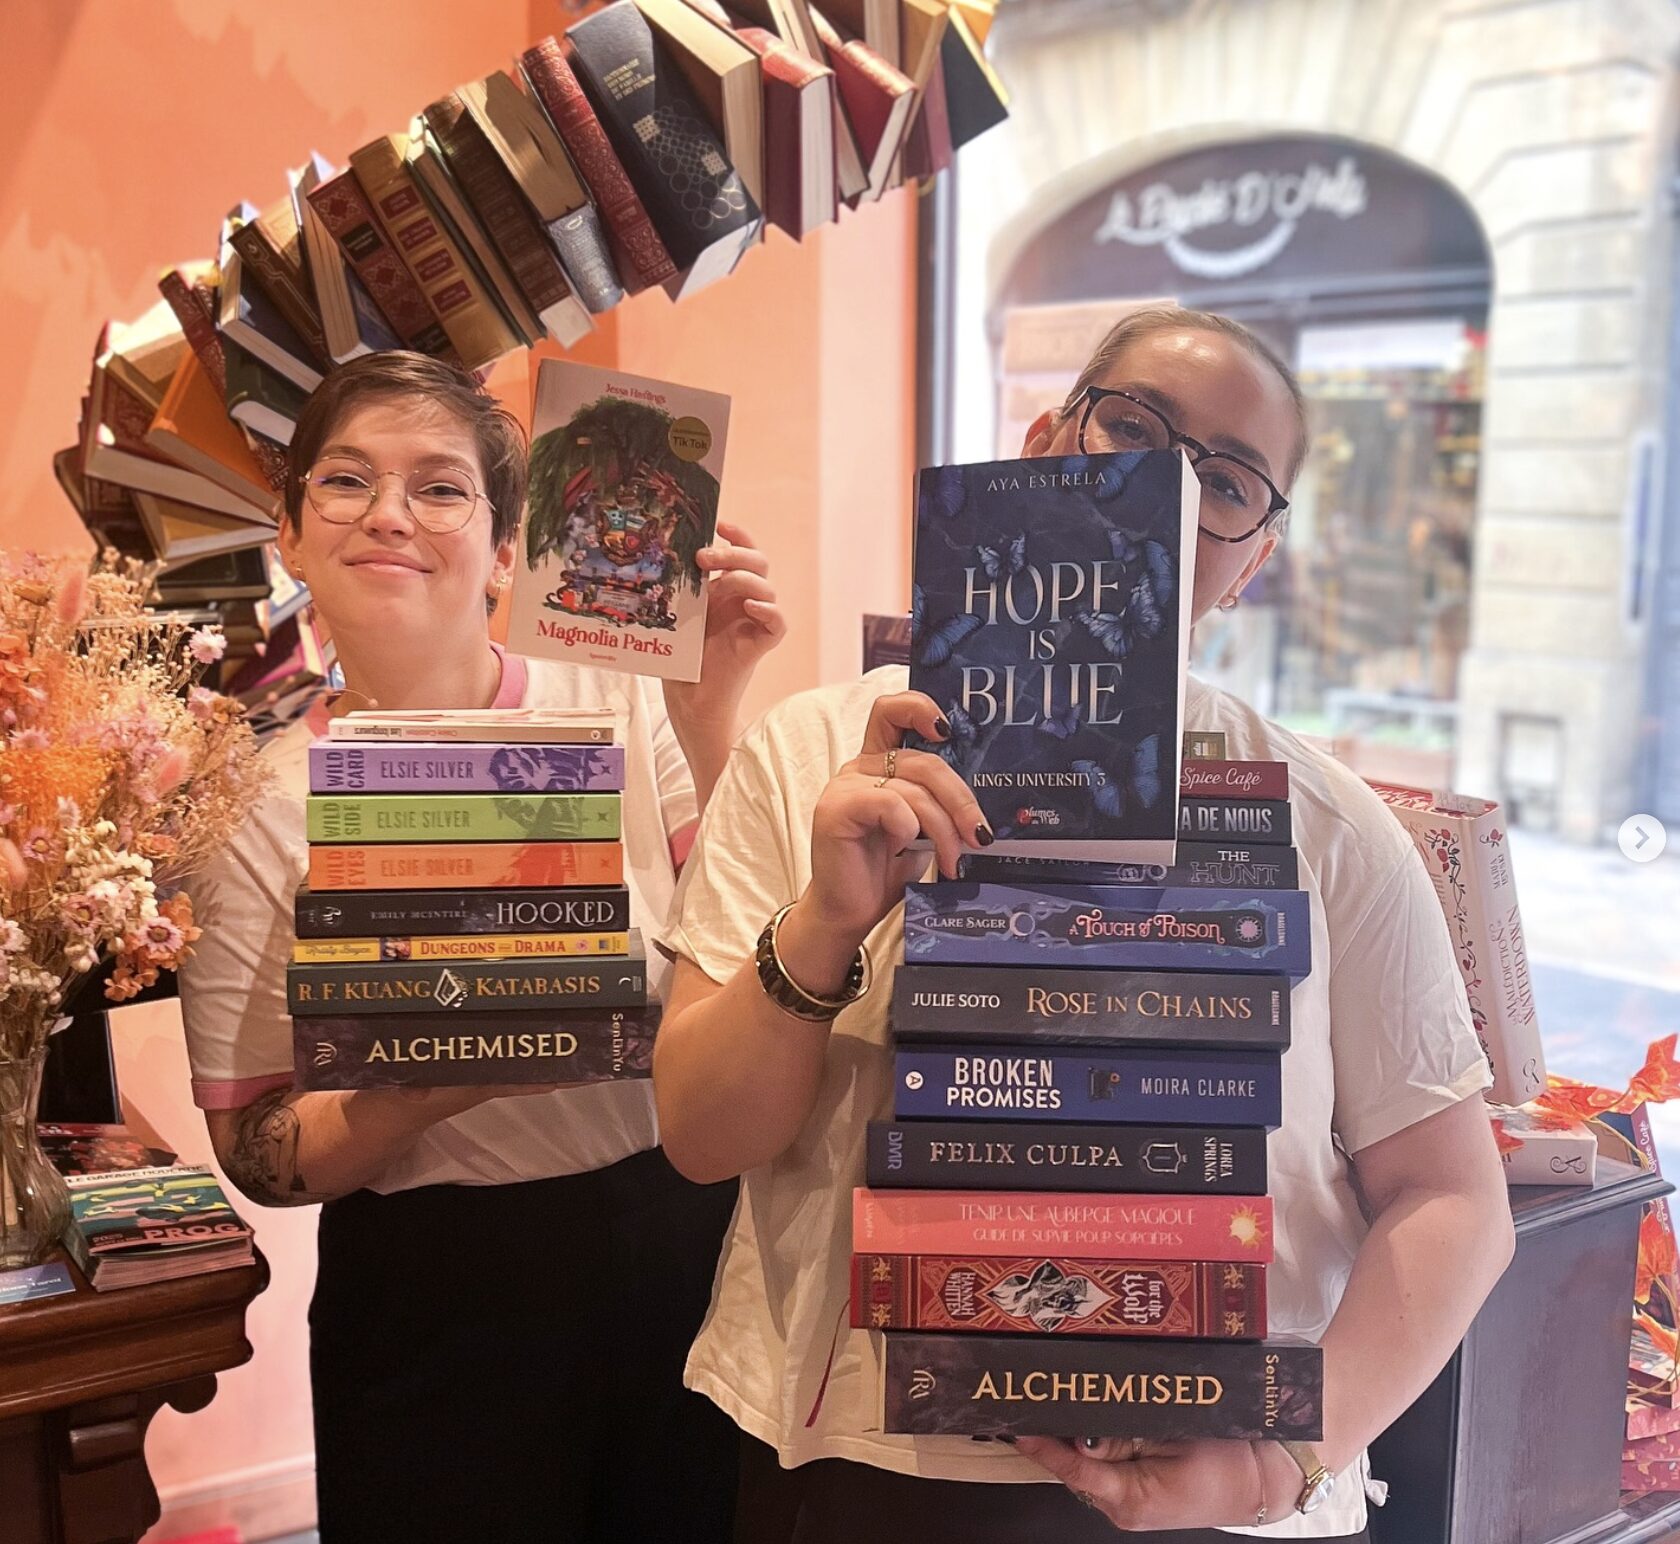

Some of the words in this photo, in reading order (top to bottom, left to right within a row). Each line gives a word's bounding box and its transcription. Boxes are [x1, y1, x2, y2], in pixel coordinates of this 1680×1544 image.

[605, 383, 629, 398] Jessa
[987, 477, 1020, 492] AYA
[1029, 472, 1106, 489] ESTRELA
[964, 560, 1127, 626] HOPE
[536, 619, 619, 648] Magnolia
[622, 633, 673, 656] Parks
[1028, 629, 1056, 660] IS
[961, 661, 1124, 727] BLUE
[326, 752, 344, 787] WILD
[348, 750, 365, 789] CARD
[380, 761, 419, 779] ELSIE
[425, 761, 474, 779] SILVER
[973, 772, 1013, 787] KING'S
[1016, 772, 1091, 787] UNIVERSITY
[1179, 767, 1223, 790] Spice
[1225, 767, 1262, 791] Café
[322, 802, 340, 837] WILD
[343, 804, 361, 836] SIDE
[377, 811, 417, 829] ELSIE
[422, 810, 471, 828] SILVER
[1197, 806, 1219, 832] DE
[1224, 807, 1273, 833] NOUS
[326, 851, 344, 887] WILD
[347, 851, 366, 886] EYES
[380, 859, 418, 877] ELSIE
[425, 858, 474, 876] SILVER
[1217, 850, 1250, 862] THE
[1190, 862, 1280, 885] HUNT
[496, 901, 615, 927] HOOKED
[420, 941, 496, 955] DUNGEONS
[514, 939, 567, 954] DRAMA
[344, 980, 431, 1000] KUANG
[476, 976, 601, 997] KATABASIS
[911, 992, 955, 1007] JULIE
[958, 993, 1001, 1009] SOTO
[1026, 987, 1097, 1017] ROSE
[1107, 996, 1128, 1013] IN
[1137, 991, 1253, 1019] CHAINS
[364, 1032, 578, 1063] ALCHEMISED
[954, 1057, 1054, 1087] BROKEN
[946, 1088, 1062, 1110] PROMISES
[1140, 1079, 1190, 1096] MOIRA
[1197, 1079, 1256, 1098] CLARKE
[886, 1131, 903, 1170] DMR
[929, 1141, 1015, 1165] FELIX
[1026, 1144, 1124, 1167] CULPA
[1203, 1137, 1217, 1182] SPRINGS
[1219, 1142, 1233, 1178] LOREA
[1007, 1204, 1038, 1222] UNE
[1046, 1205, 1115, 1228] AUBERGE
[1120, 1207, 1196, 1226] MAGIQUE
[144, 1223, 240, 1242] PROG
[972, 1228, 1010, 1241] GUIDE
[1012, 1228, 1026, 1241] DE
[1031, 1229, 1073, 1242] SURVIE
[1075, 1229, 1112, 1243] POUR
[945, 1271, 961, 1316] WHITTEN
[961, 1271, 977, 1316] HANNAH
[1120, 1272, 1149, 1324] Wolf
[1149, 1280, 1165, 1298] for
[1148, 1299, 1165, 1319] the
[971, 1372, 1225, 1406] ALCHEMISED
